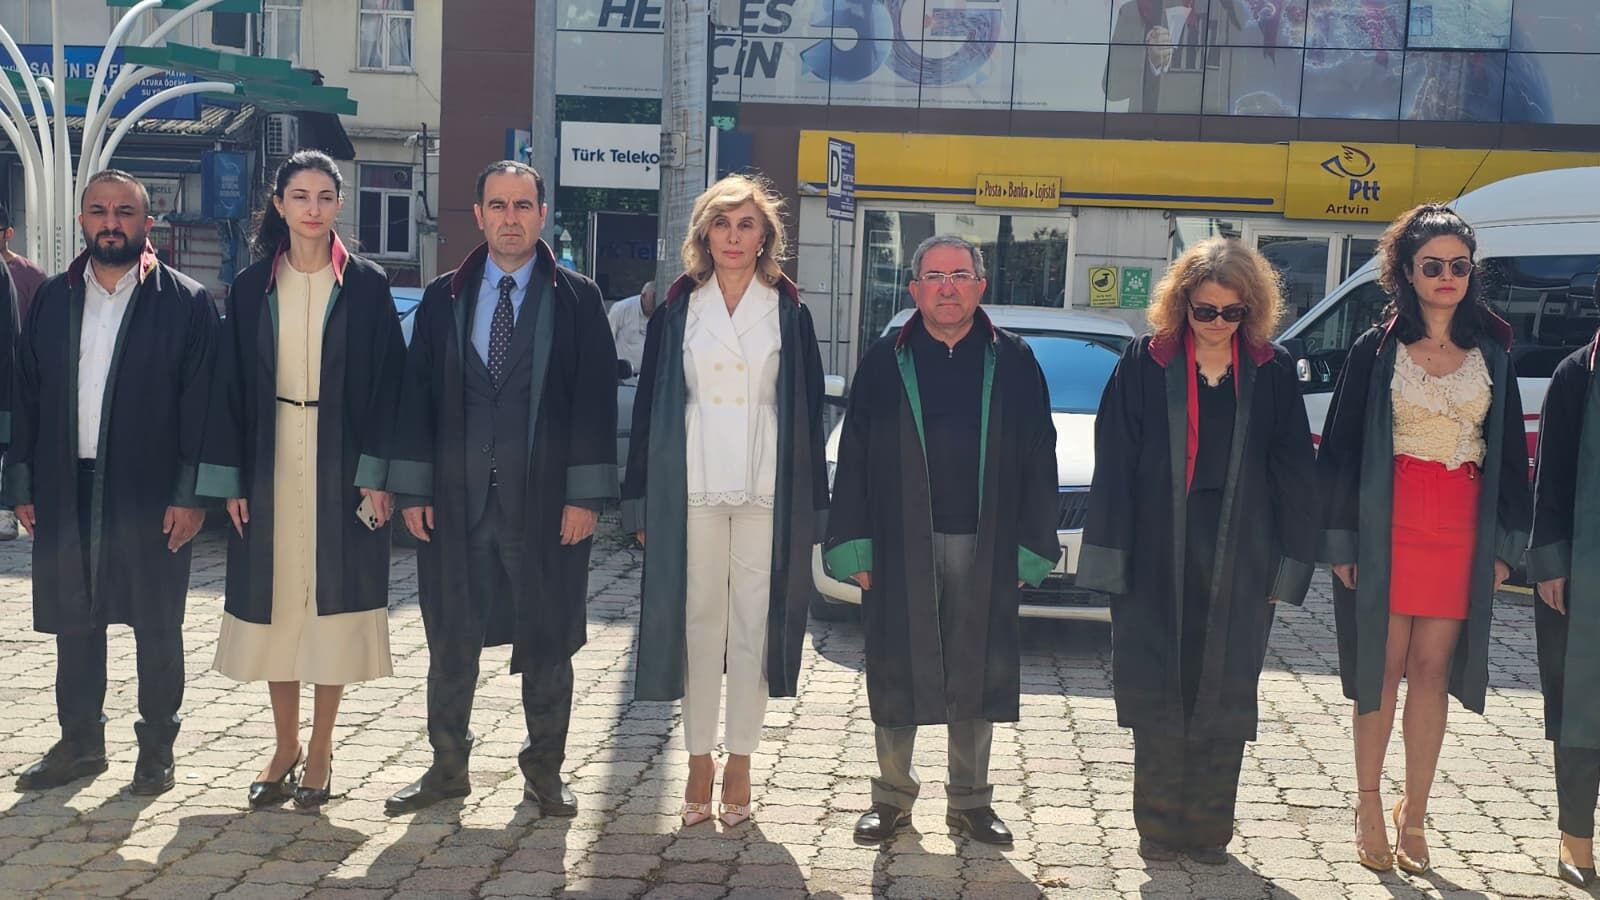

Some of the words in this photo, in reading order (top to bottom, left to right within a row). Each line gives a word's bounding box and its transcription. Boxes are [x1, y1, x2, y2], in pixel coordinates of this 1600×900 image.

[597, 0, 796, 35] HEES
[799, 0, 1003, 86] 5G
[571, 147, 606, 162] Türk
[609, 148, 661, 165] Teleko
[830, 150, 840, 188] D
[984, 180, 1002, 198] Posta
[1008, 181, 1028, 199] Banka
[1035, 182, 1057, 202] Lojistik
[1349, 178, 1381, 202] Ptt
[1325, 203, 1369, 216] Artvin
